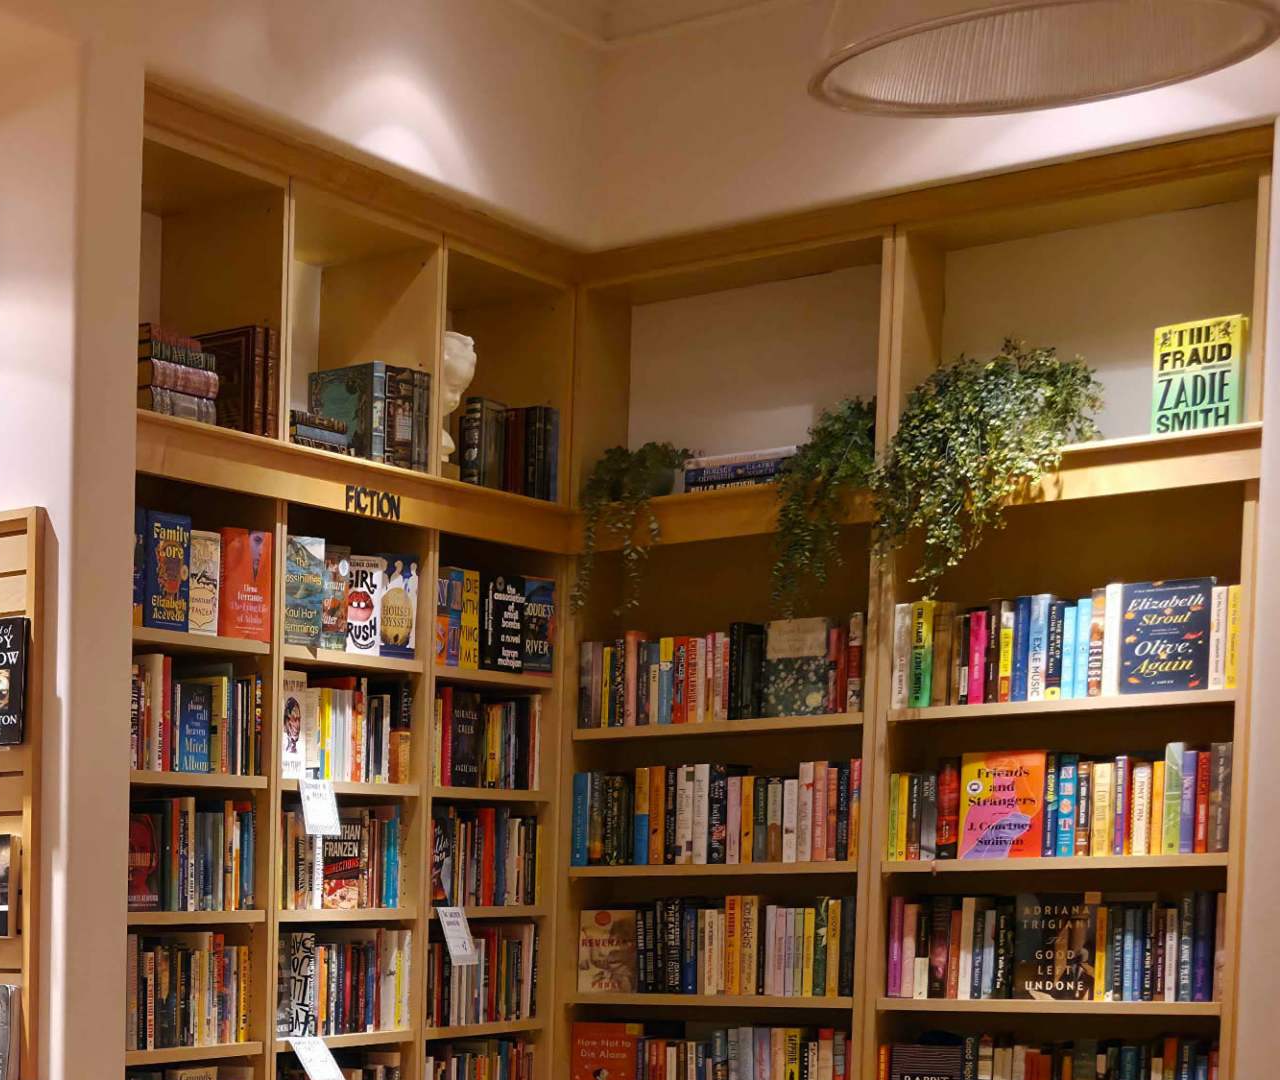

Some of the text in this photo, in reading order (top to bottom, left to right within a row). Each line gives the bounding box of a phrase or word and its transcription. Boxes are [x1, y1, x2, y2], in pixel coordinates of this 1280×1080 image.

[1176, 325, 1216, 348] THE
[1158, 343, 1233, 372] FRAUD
[1157, 369, 1232, 412] ZADIE
[1156, 405, 1230, 434] SMITH
[345, 485, 401, 521] FICTION
[153, 522, 190, 547] Family
[295, 557, 309, 567] The
[507, 585, 516, 594] the
[524, 603, 555, 617] GODDESS
[1128, 592, 1205, 614] Elizabeth
[152, 608, 185, 622] Acevedo
[302, 607, 317, 618] Hart
[1141, 611, 1191, 628] Strout
[2, 625, 12, 635] of
[506, 634, 521, 643] novel
[525, 639, 549, 655] RIVER
[1134, 637, 1193, 658] Olive,
[1133, 658, 1193, 677] Again
[1031, 664, 1040, 698] MUSIC
[184, 738, 209, 754] Mitch
[181, 755, 209, 772] Albom
[976, 765, 1031, 779] Friends
[988, 780, 1015, 793] and
[968, 793, 1036, 808] Strangers
[967, 820, 1033, 833] J. Courtney
[976, 834, 1025, 847] Sullivan
[324, 841, 359, 857] FRANZEN
[1023, 905, 1091, 916] ADRIANA
[1023, 918, 1091, 929] TRIGIANI
[1035, 950, 1075, 961] GOOD
[1037, 965, 1073, 976] LEFT
[1024, 980, 1085, 992] UNDONE
[580, 1049, 628, 1059] Die Alone
